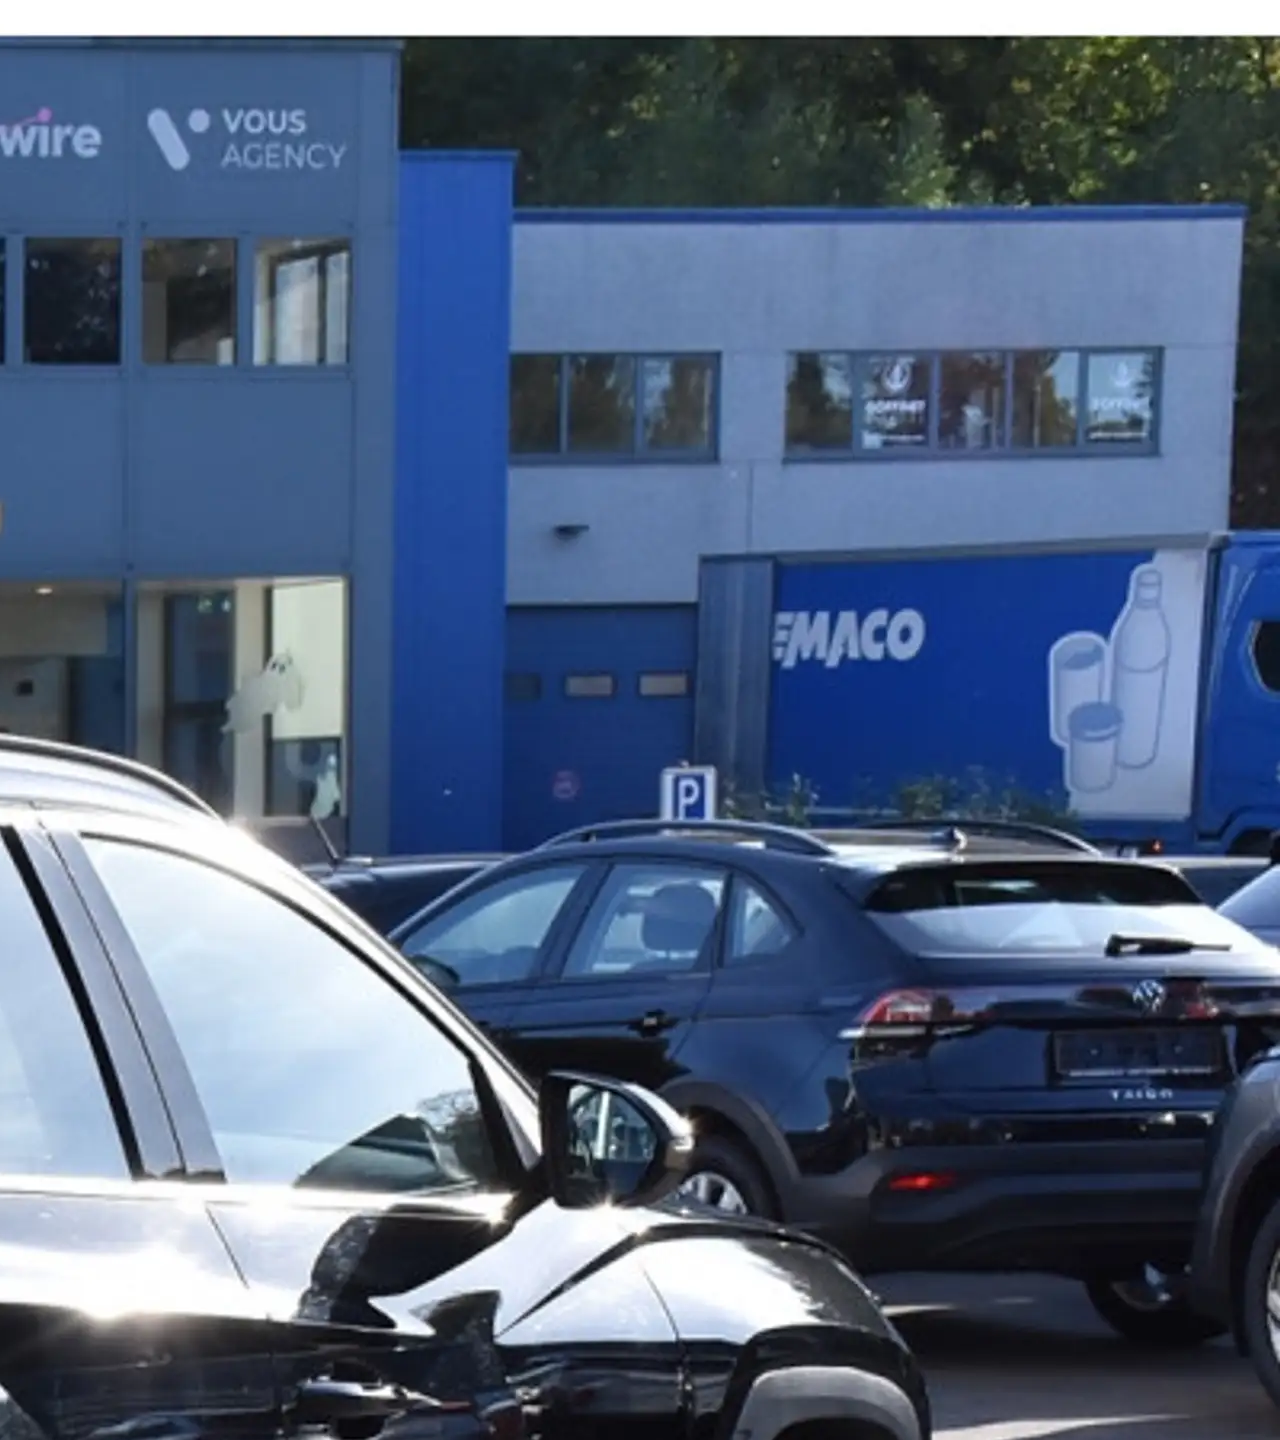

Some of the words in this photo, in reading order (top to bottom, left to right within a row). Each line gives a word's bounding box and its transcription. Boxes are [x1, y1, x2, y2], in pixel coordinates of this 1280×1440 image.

[222, 108, 307, 134] VOUS
[221, 143, 348, 169] AGENCY
[678, 777, 700, 820] P
